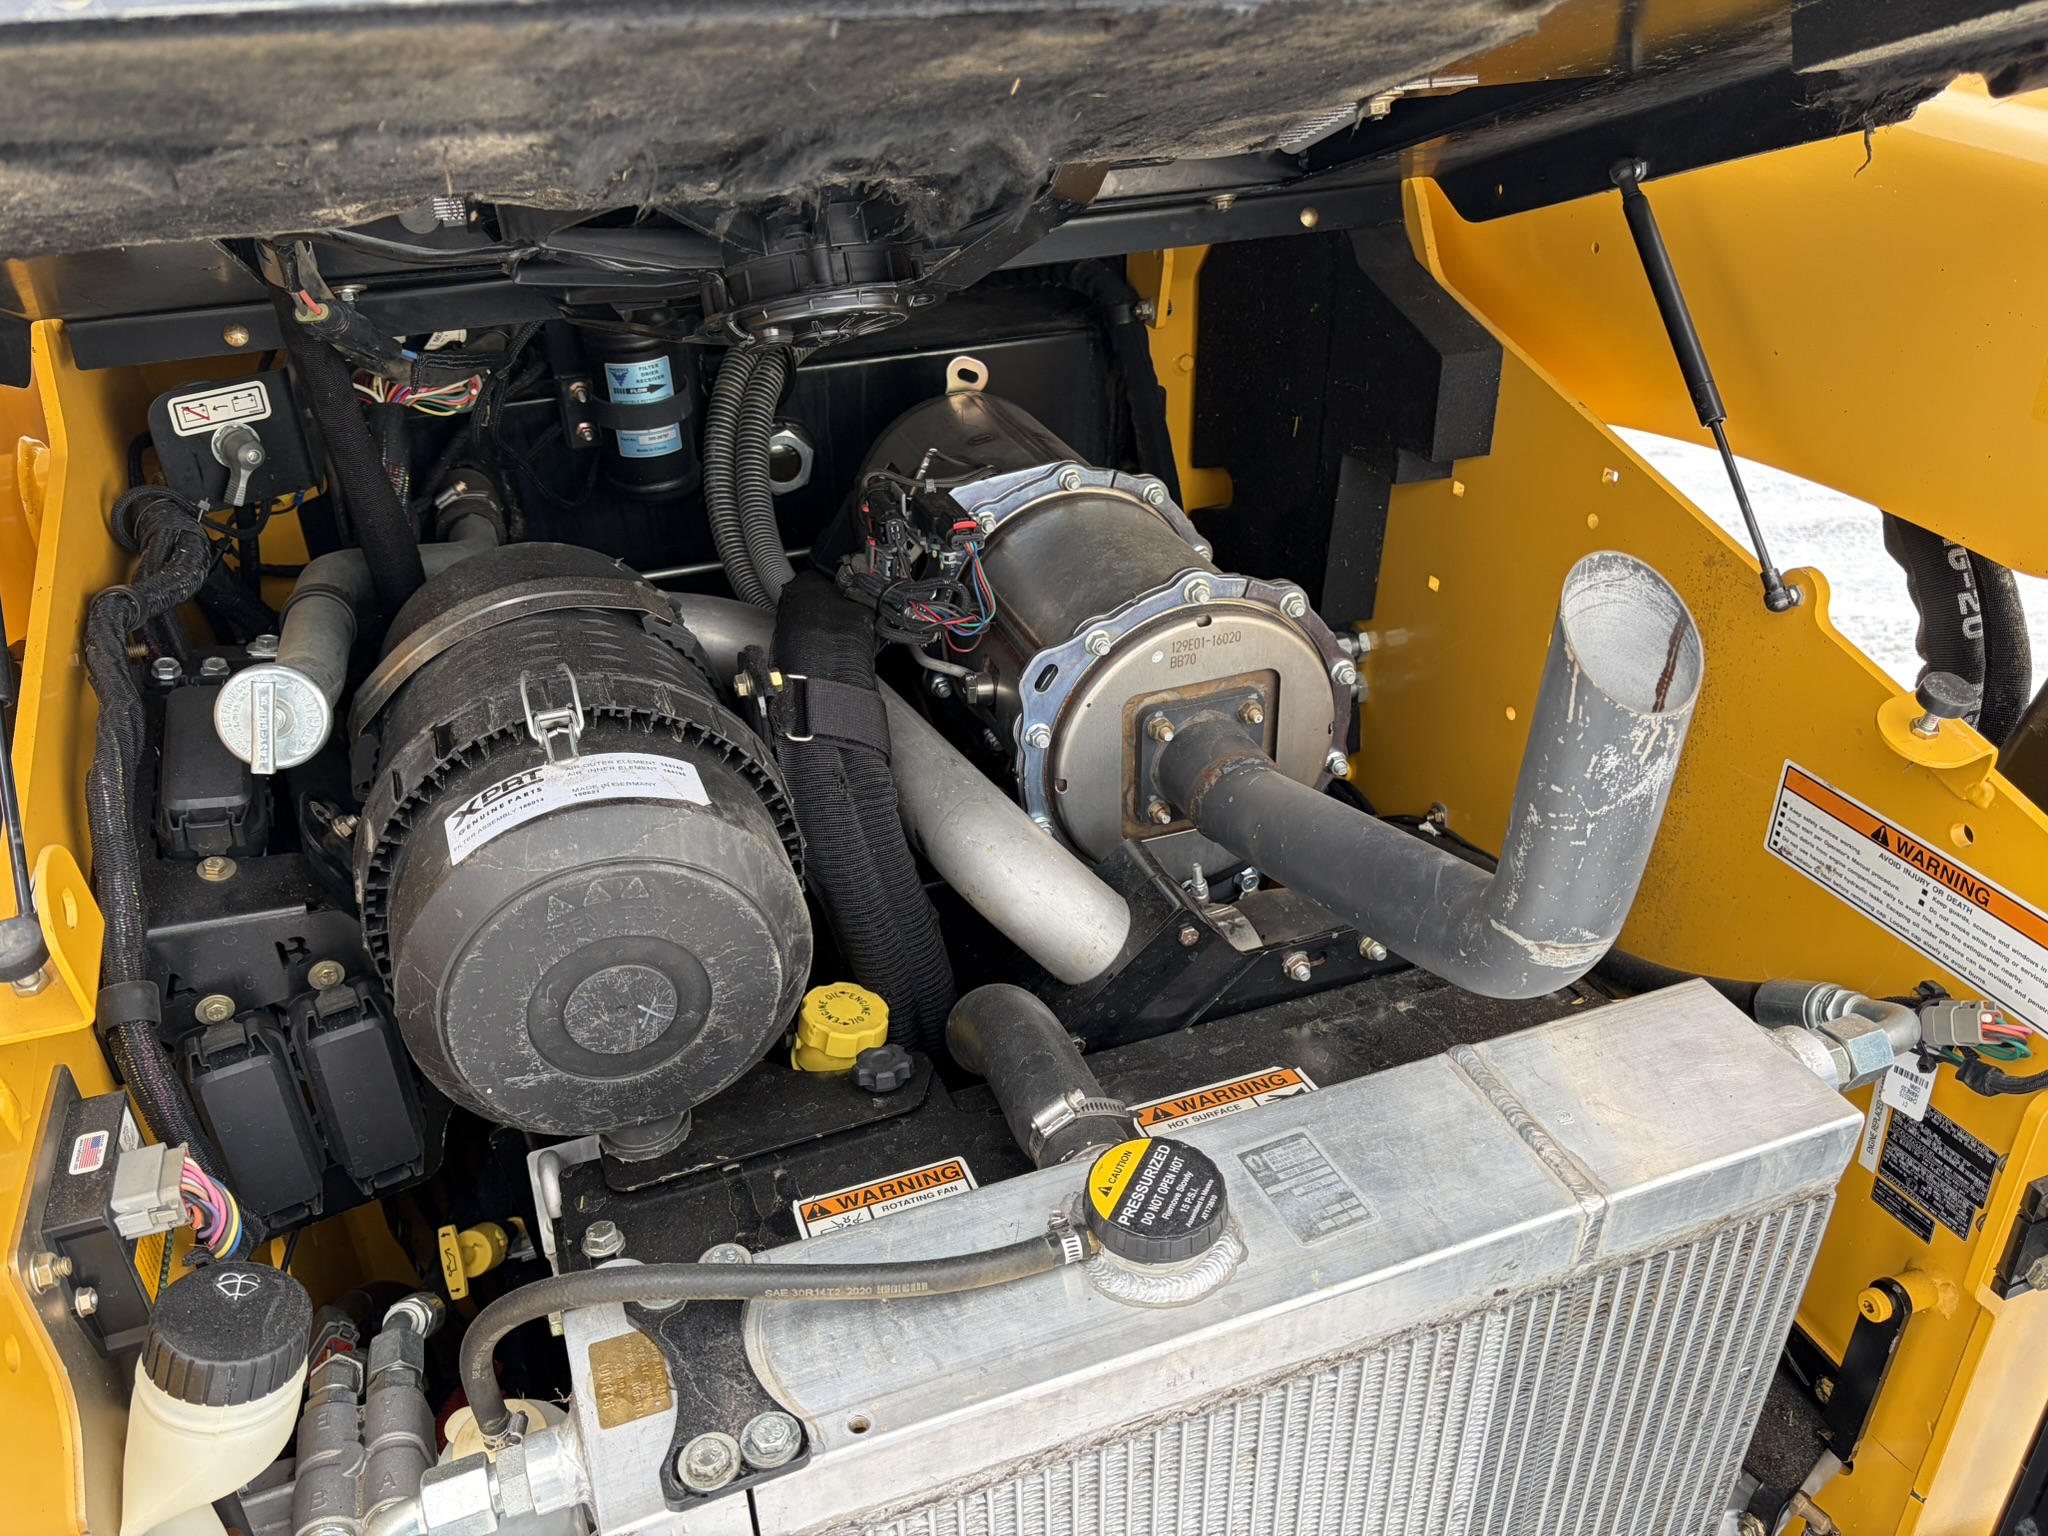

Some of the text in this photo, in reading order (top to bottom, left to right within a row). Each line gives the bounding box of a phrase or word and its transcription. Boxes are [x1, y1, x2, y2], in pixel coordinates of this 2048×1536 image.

[635, 374, 665, 384] RECEIVER
[638, 363, 660, 371] FILTER
[1172, 630, 1242, 653] 129E01-16020
[1170, 653, 1197, 668] BB70
[565, 764, 583, 772] AIR
[587, 760, 614, 769] OUTER
[567, 769, 583, 778] AIR
[587, 767, 617, 775] INNER
[571, 786, 599, 794] MADE
[613, 781, 657, 789] GERMANY
[458, 787, 543, 836] GENUINE PARTS
[453, 832, 478, 853] FILTER
[477, 808, 518, 834] ASSEMBLY
[1789, 806, 1860, 855] Keep safety devices working.
[1786, 816, 1800, 828] Jump
[1801, 826, 1813, 835] start
[1823, 839, 1849, 859] Operator's
[1851, 856, 1870, 872] Manual
[1870, 870, 1899, 891] procedure.
[1896, 836, 1991, 908] WARNING
[1878, 852, 1901, 869] AVOID
[1902, 867, 1930, 887] INJURY
[1945, 894, 1972, 915] DEATH
[1784, 825, 1798, 837] Clean
[1798, 836, 1814, 848] debris
[1815, 845, 1827, 856] from
[1828, 855, 1846, 868] engine
[1846, 867, 1881, 891] compartment
[1882, 889, 1896, 901] daily
[1904, 904, 1921, 916] avoid
[1921, 914, 1932, 925] fire.
[1934, 922, 1949, 935] Keep
[1951, 933, 1961, 943] fire
[1962, 941, 1999, 967] extinguisher
[2000, 966, 2022, 984] nearby.
[1789, 841, 1798, 849] not
[1798, 847, 1808, 855] use
[1809, 853, 1824, 866] hands
[1843, 875, 1867, 894] hydraulic
[1868, 892, 1883, 905] leaks.
[1885, 902, 1911, 923] Escaping
[1920, 926, 1937, 939] under
[1938, 938, 1964, 957] pressure
[1965, 956, 1976, 966] can
[1987, 969, 2012, 990] invisible
[2014, 988, 2026, 999] and
[1793, 855, 1812, 869] radiator
[1820, 870, 1832, 882] cool
[1832, 879, 1849, 894] before
[1850, 892, 1874, 911] removing
[1875, 909, 1886, 918] cap.
[1888, 917, 1909, 933] Loosen
[1910, 932, 1921, 941] cap
[1922, 940, 1941, 955] slowly
[1950, 958, 1967, 972] avoid
[1967, 969, 1986, 985] burns.
[1931, 896, 1947, 909] Keep
[1948, 907, 1970, 924] guards,
[1972, 922, 1996, 940] screens
[1997, 938, 2010, 949] and
[2011, 947, 2038, 967] windows
[1938, 913, 1949, 922] not
[1950, 921, 1970, 936] smoke
[1971, 934, 1987, 947] while
[1988, 945, 2010, 963] fueling
[818, 991, 841, 1024] ENGINE OIL
[848, 992, 870, 1025] ENGINE OIL
[1173, 1073, 1289, 1113] WARNING
[1167, 1103, 1242, 1130] HOT SURFACE
[1872, 1100, 1884, 1132] REPLACED
[1866, 1132, 1879, 1155] ENGINE
[1108, 1150, 1133, 1184] CAUTION
[1117, 1144, 1171, 1226] PRESSURIZED
[835, 1165, 961, 1210] WARNING
[881, 1185, 958, 1212] ROTATING FAN
[1140, 1155, 1185, 1226] DO NOT OPEN HOT
[1161, 1170, 1194, 1220] Remove Slowly
[1180, 1203, 1190, 1213] 15
[765, 1289, 788, 1297] SAE
[846, 1286, 873, 1295] 2020
